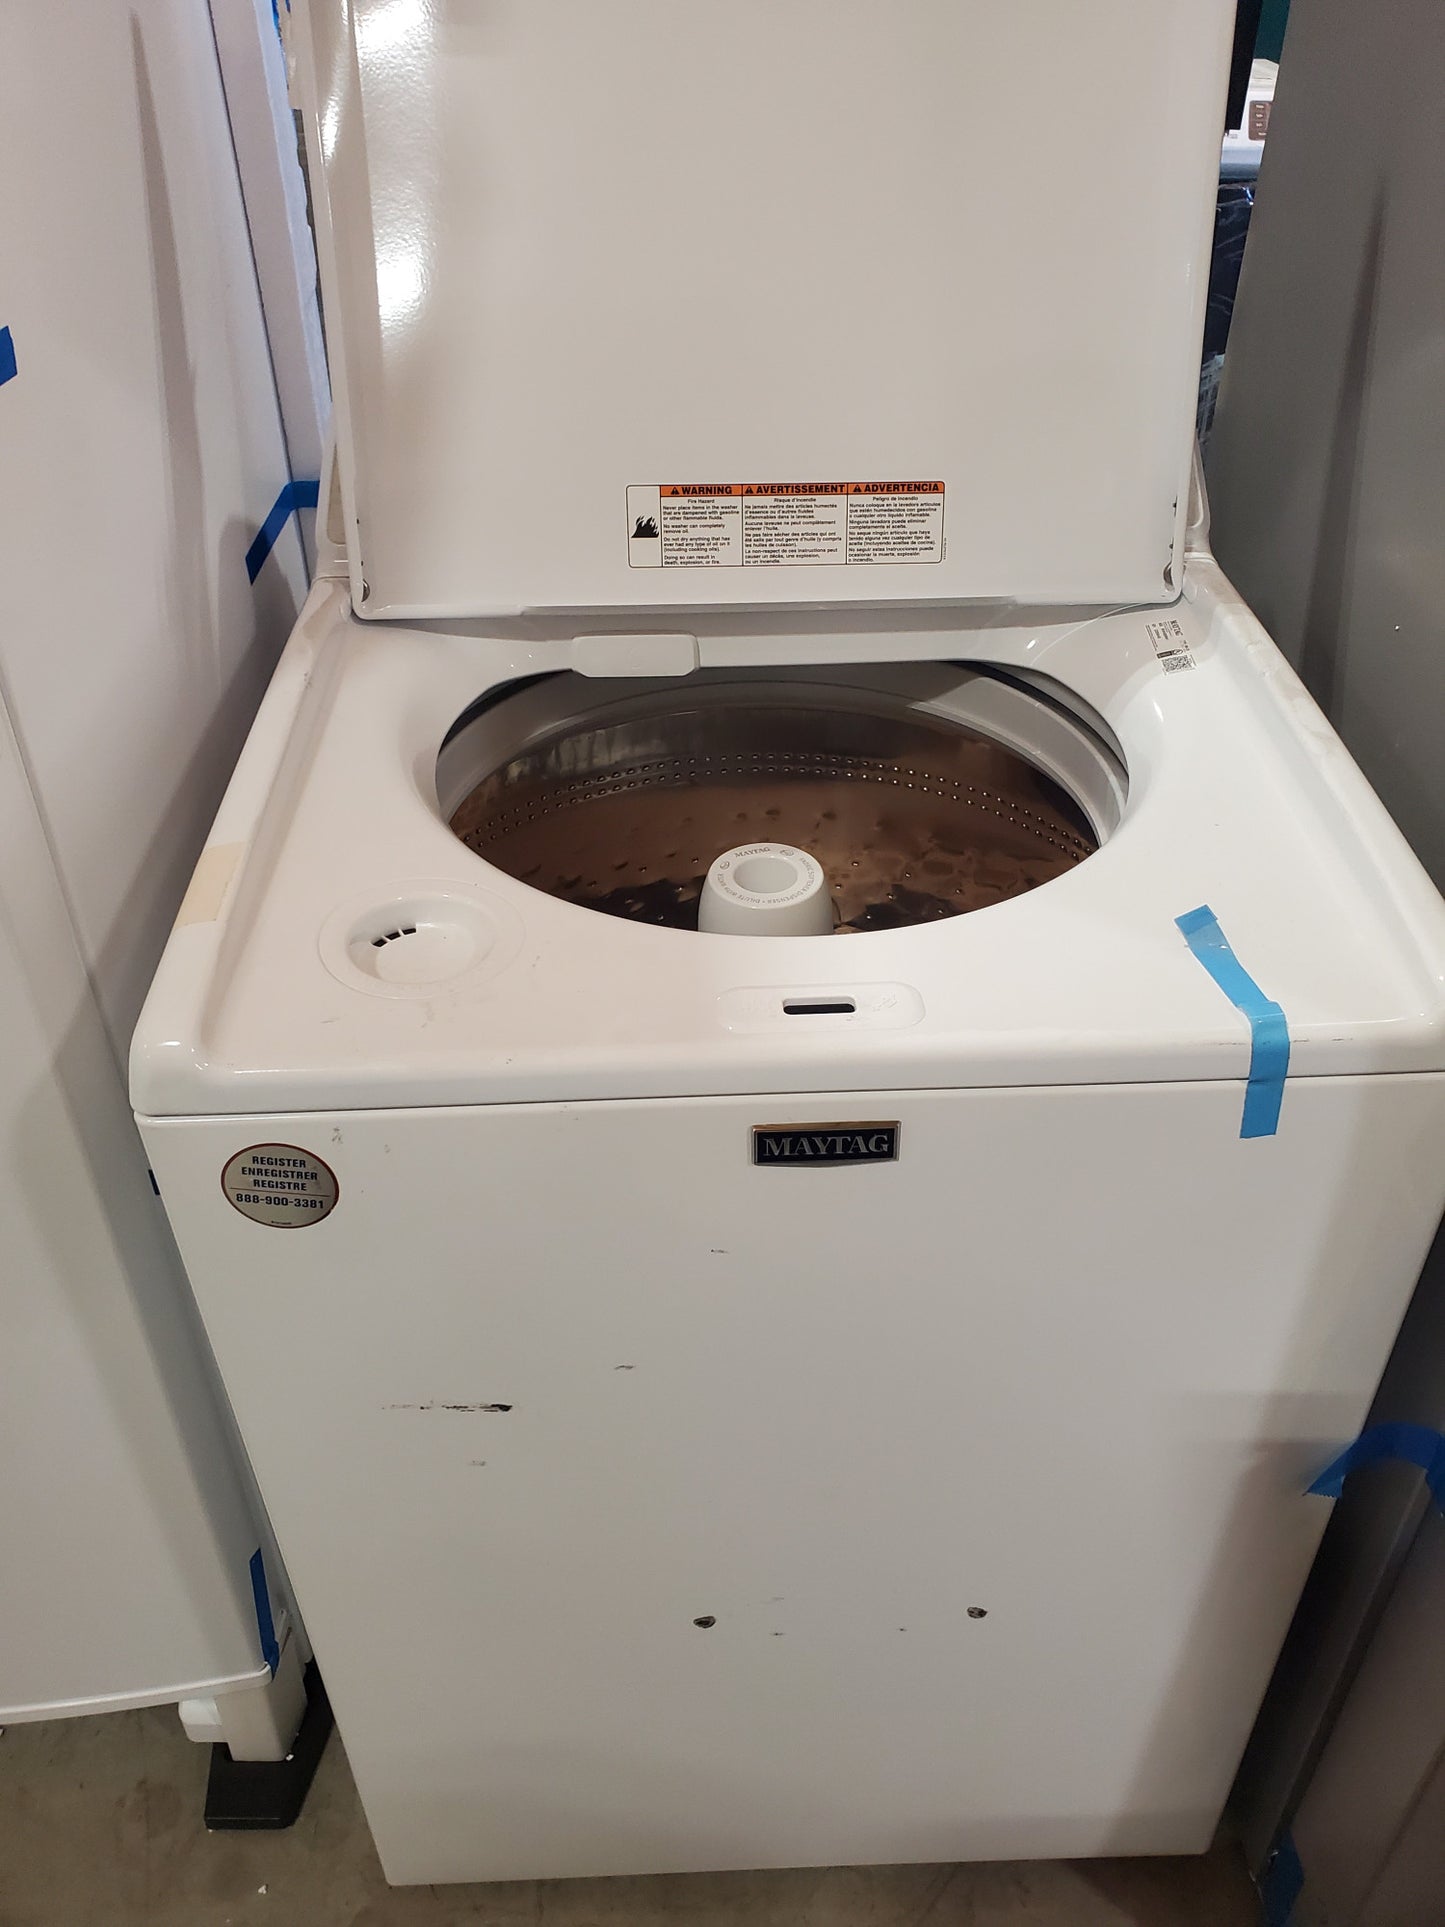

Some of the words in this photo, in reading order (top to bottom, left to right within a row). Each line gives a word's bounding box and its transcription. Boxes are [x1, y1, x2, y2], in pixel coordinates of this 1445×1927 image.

[682, 486, 732, 494] WARNING
[756, 485, 845, 493] AVERTISSEMENT
[864, 484, 939, 492] ADVERTENCIA
[735, 847, 770, 858] MAYTAG
[764, 1134, 889, 1156] MAYTAG
[252, 1156, 306, 1168] REGISTER
[242, 1167, 318, 1180] ENREGISTRER
[253, 1179, 307, 1191] REGISTRE
[236, 1194, 324, 1208] 888-900-3381
